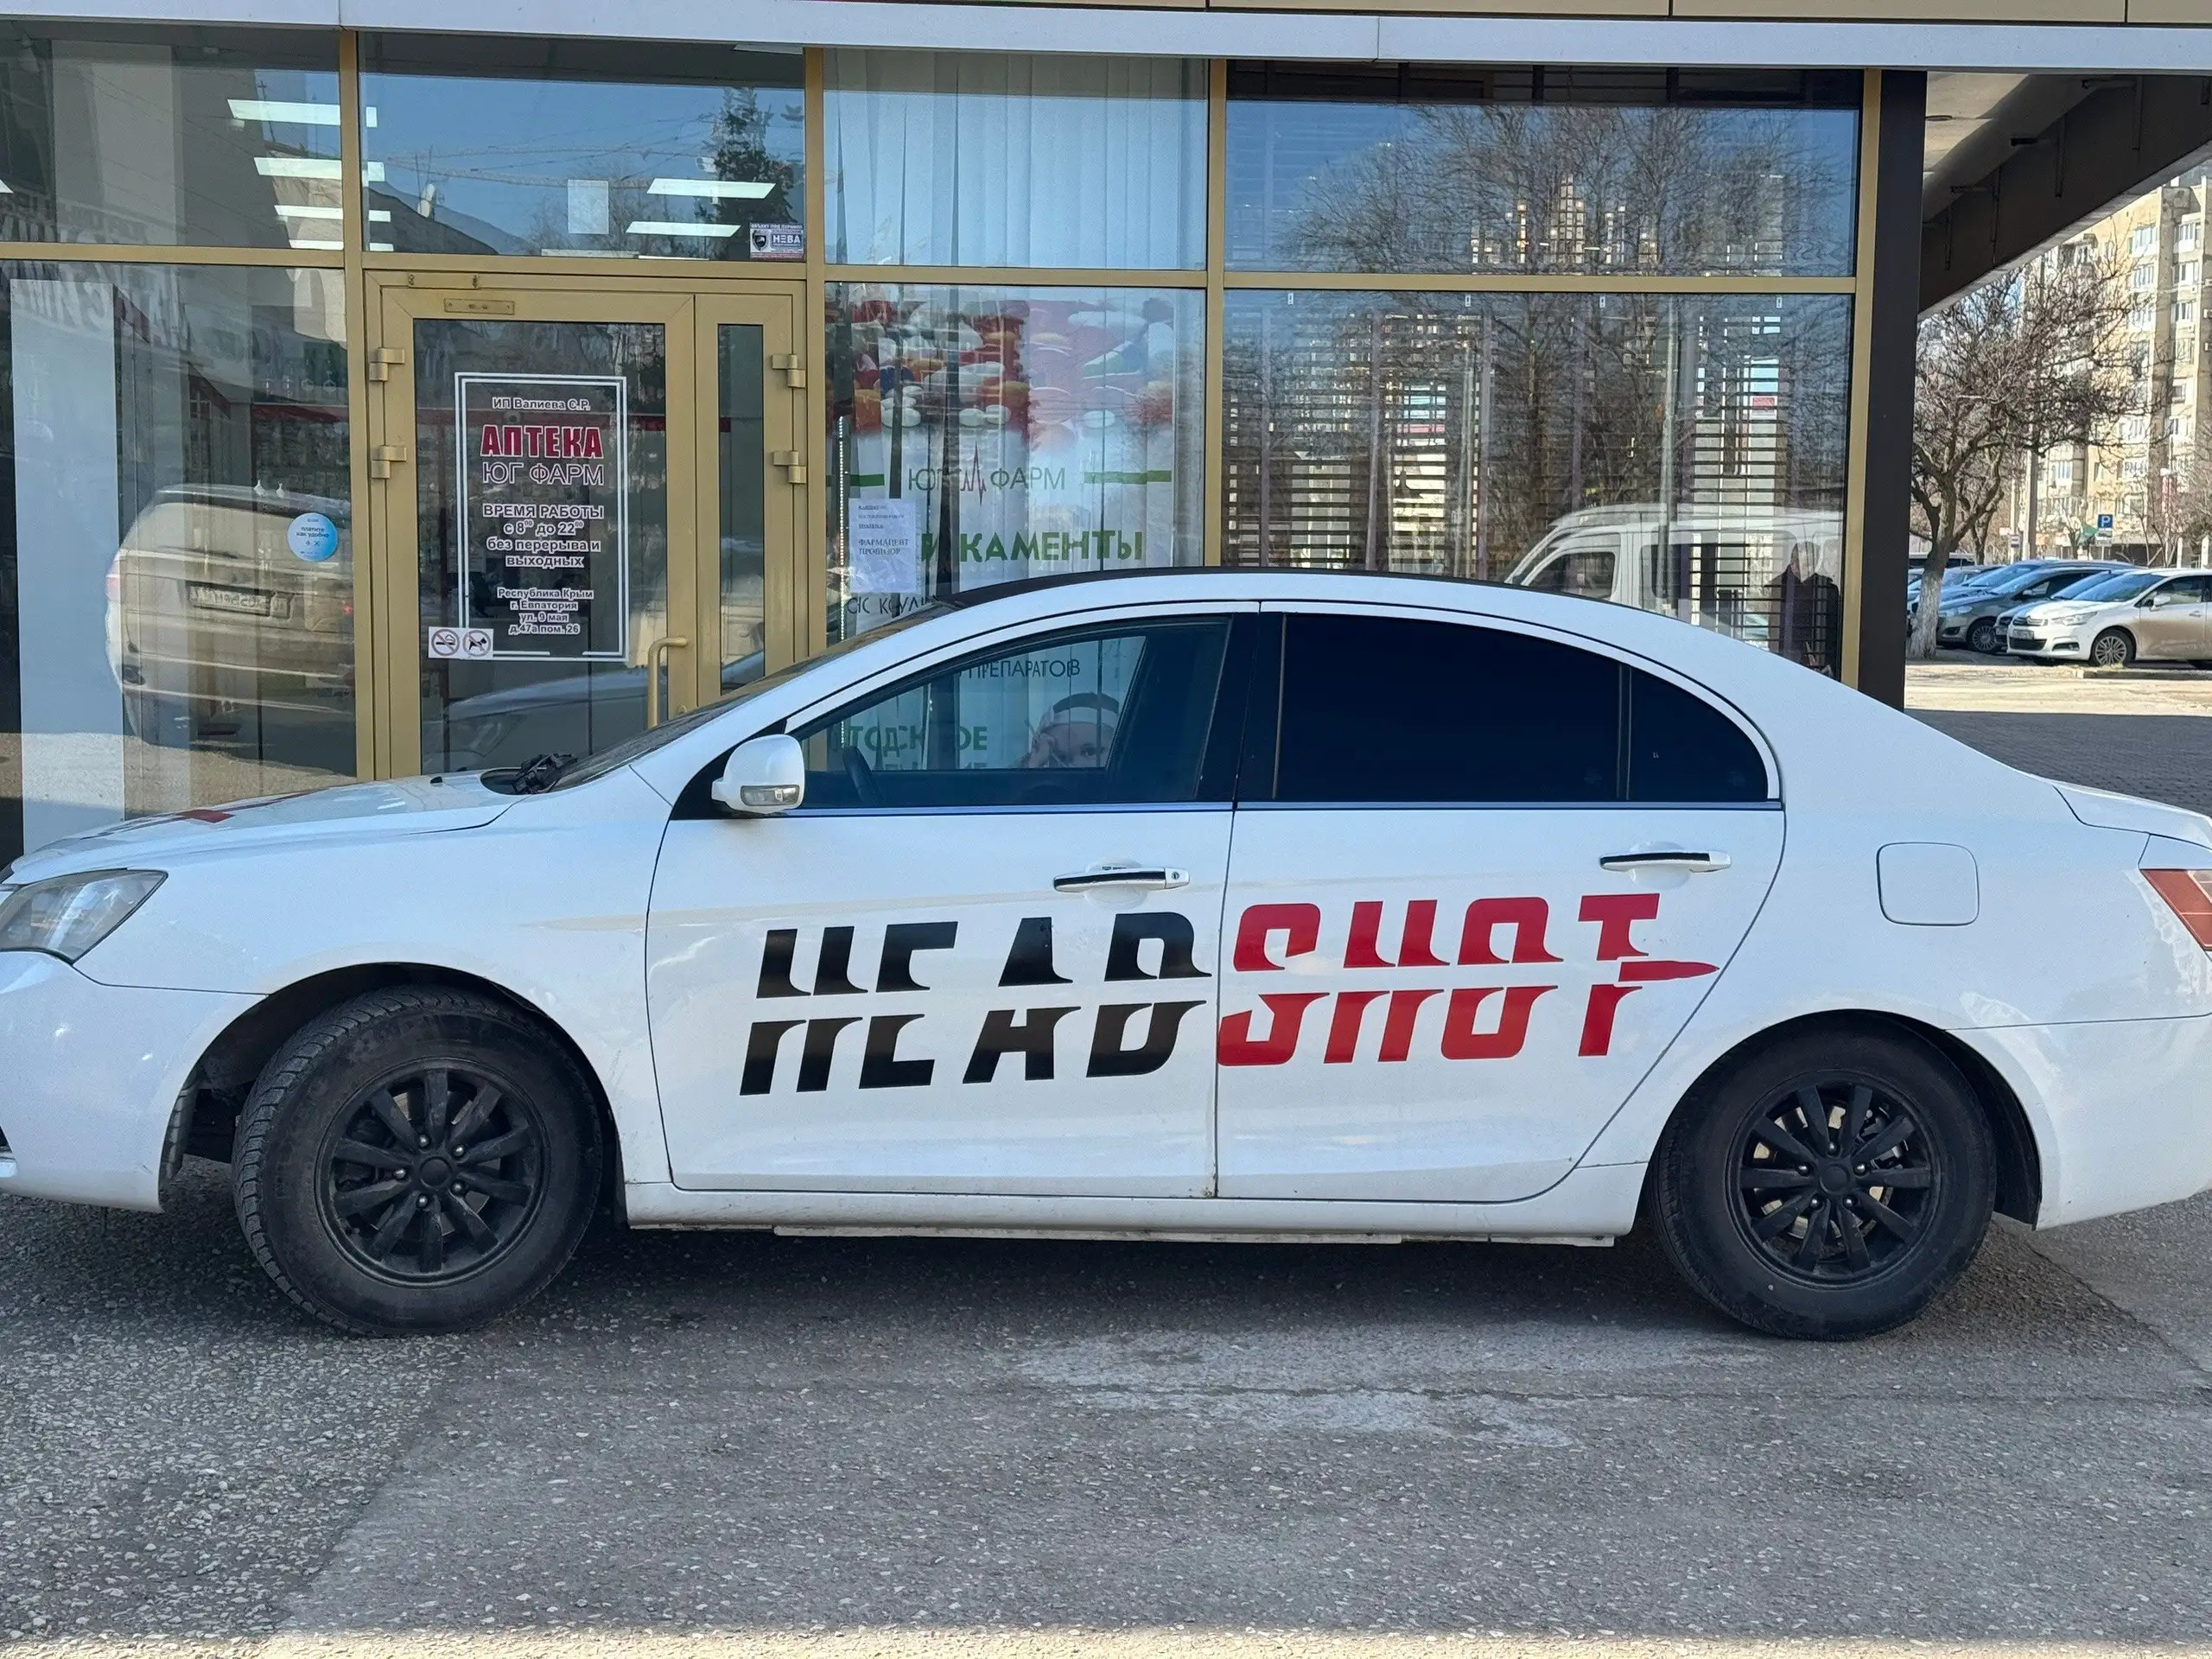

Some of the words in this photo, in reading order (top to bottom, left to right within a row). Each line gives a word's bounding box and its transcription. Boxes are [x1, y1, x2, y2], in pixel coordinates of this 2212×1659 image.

[493, 397, 511, 409] ИП
[513, 397, 566, 410] Валиева
[568, 398, 591, 410] С.Р.
[480, 424, 604, 459] АПТЕКА
[482, 461, 524, 484] ЮГ
[530, 463, 604, 486] ФАРМ
[990, 467, 1065, 491] ФАРМ
[483, 503, 536, 518] ВРЕМЯ
[539, 505, 604, 518] РАБОТЫ
[504, 524, 514, 534] с
[536, 525, 556, 536] до
[486, 537, 512, 550] без
[514, 539, 588, 553] перерыва
[590, 541, 601, 552] и
[505, 556, 584, 569] выходных
[497, 587, 562, 600] Республика
[562, 588, 594, 601] Крым
[519, 600, 579, 613] Евпатория
[519, 613, 537, 623] ул.
[537, 611, 546, 621] 9
[547, 613, 569, 623] мая
[566, 623, 582, 634] 26
